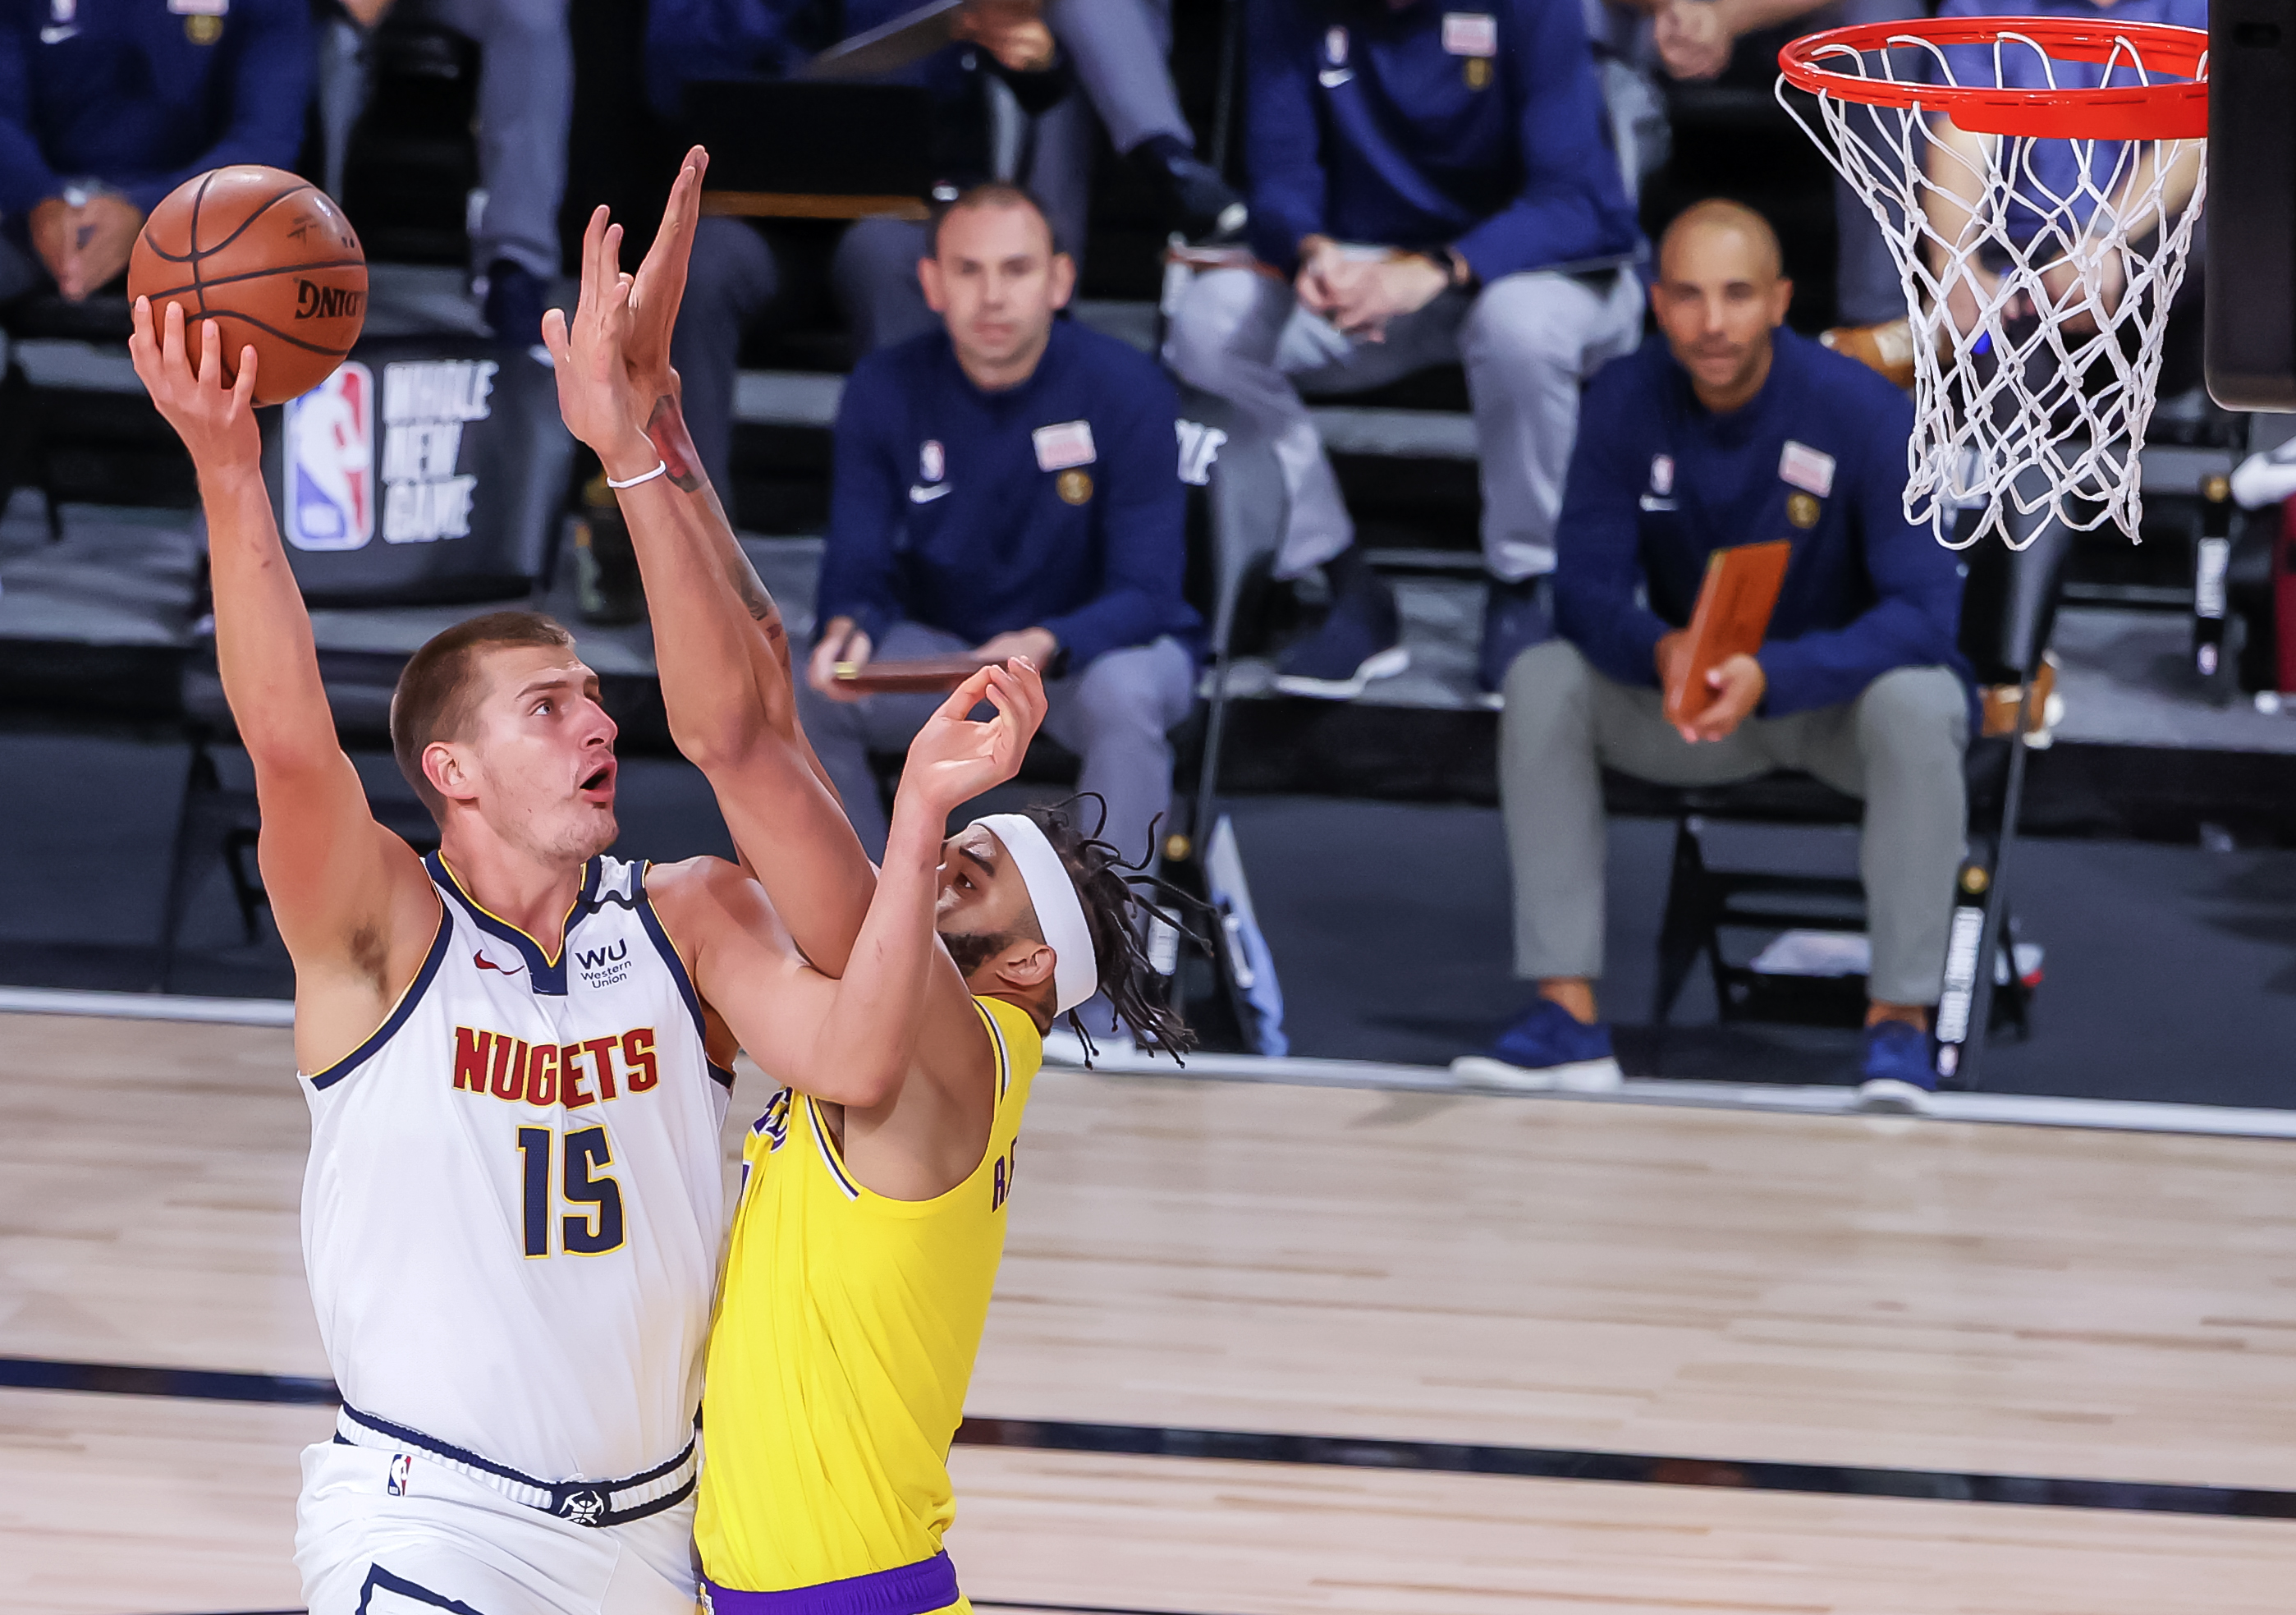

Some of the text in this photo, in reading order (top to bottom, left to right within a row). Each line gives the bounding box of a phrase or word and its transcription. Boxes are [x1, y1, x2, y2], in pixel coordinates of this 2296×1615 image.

[575, 938, 627, 970] WU
[580, 961, 632, 981] Western
[592, 973, 627, 989] Union
[516, 1124, 626, 1260] 15
